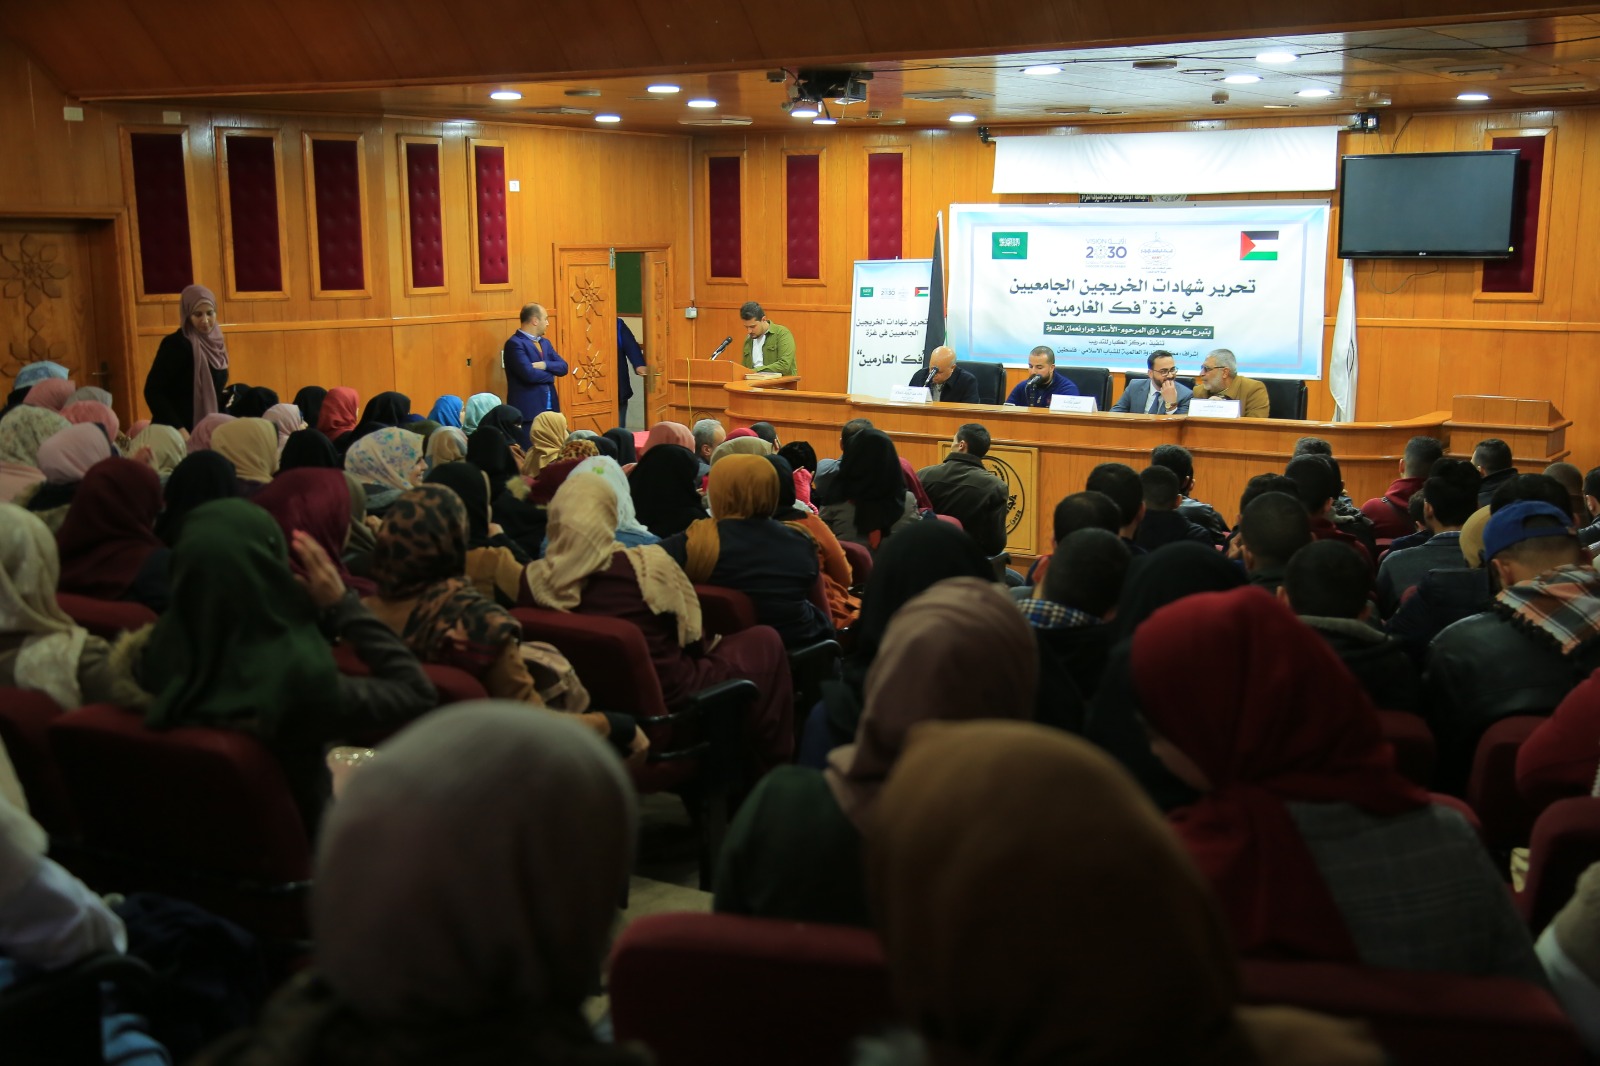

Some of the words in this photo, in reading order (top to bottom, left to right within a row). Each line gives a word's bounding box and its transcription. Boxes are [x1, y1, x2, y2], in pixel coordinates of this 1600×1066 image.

[1009, 278, 1075, 294] الجامعيين
[1079, 278, 1148, 295] الخريجين
[1152, 278, 1204, 296] شهادات
[1208, 279, 1256, 297] تحرير
[1149, 301, 1177, 319] غزة
[1182, 301, 1204, 321] في
[856, 318, 885, 327] الخريجين
[886, 318, 908, 327] شهادات
[1045, 324, 1065, 333] القدوة
[1146, 327, 1160, 336] ذوي
[1161, 328, 1171, 336] من
[1171, 327, 1193, 335] كريم
[1192, 328, 1212, 337] بتبرع
[865, 329, 877, 338] غزة
[879, 329, 888, 338] في
[889, 329, 919, 338] الجامعيين
